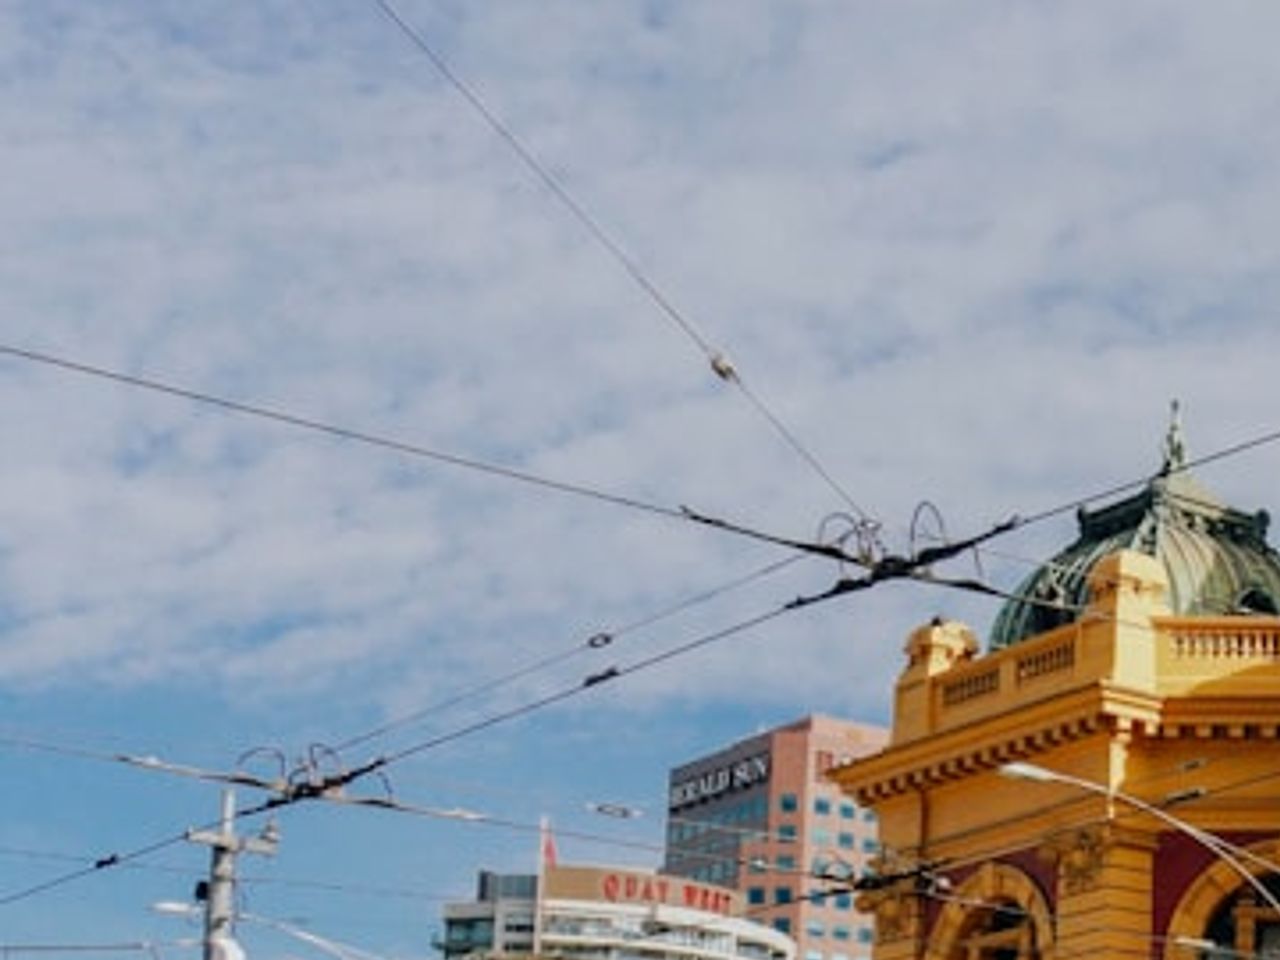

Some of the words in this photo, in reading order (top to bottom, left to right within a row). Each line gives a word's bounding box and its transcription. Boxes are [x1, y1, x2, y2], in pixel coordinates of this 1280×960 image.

[733, 754, 769, 786] SUN
[603, 873, 670, 904] QUAY
[683, 884, 732, 913] WEST
